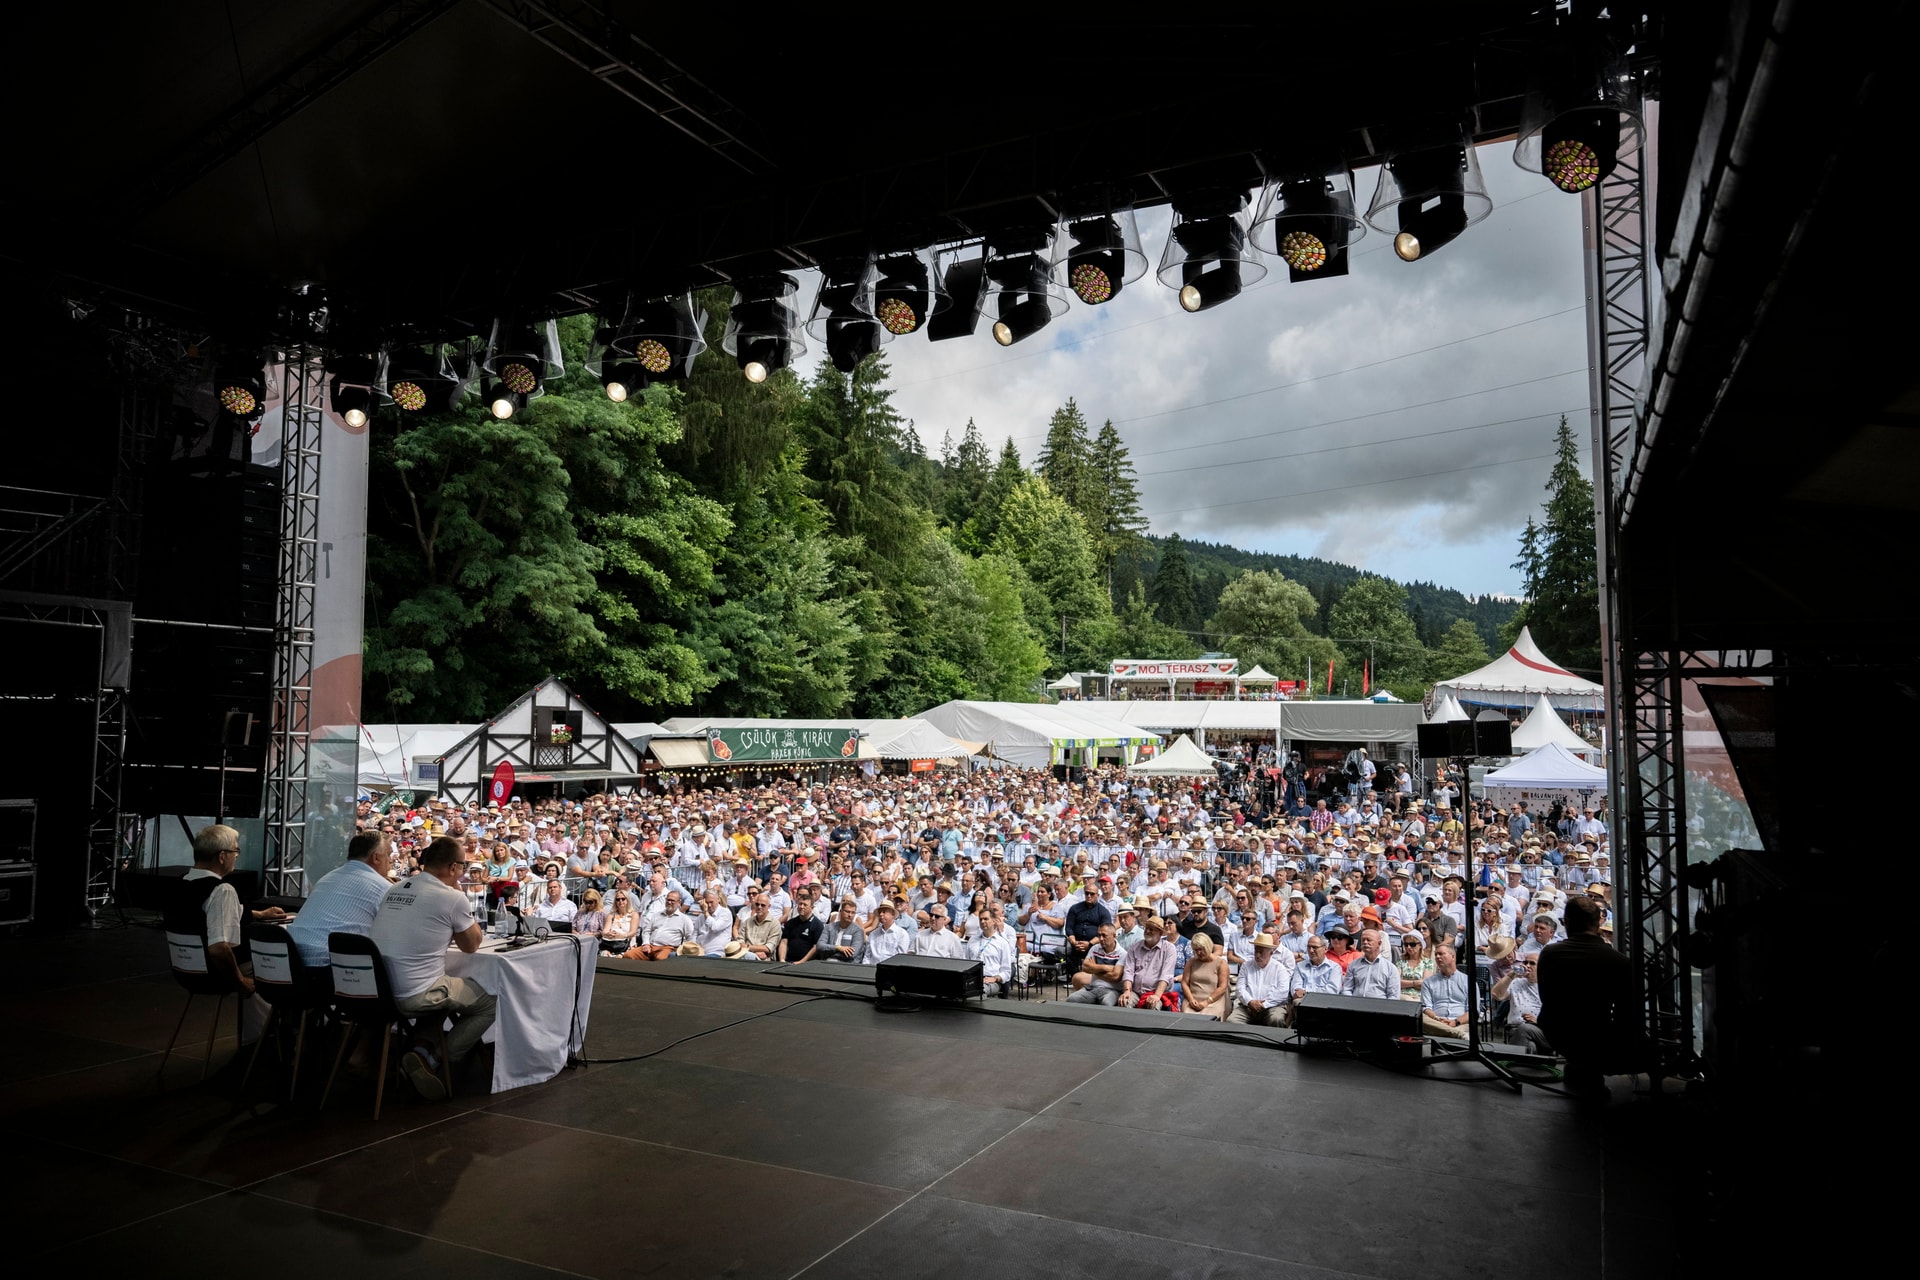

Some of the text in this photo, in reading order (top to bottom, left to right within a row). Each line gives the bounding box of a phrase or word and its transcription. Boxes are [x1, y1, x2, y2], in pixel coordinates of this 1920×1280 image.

[1138, 664, 1210, 674] MOL TERASZ
[740, 729, 833, 749] CSÜLÖK KIRÁLY
[770, 748, 792, 760] HAXEN
